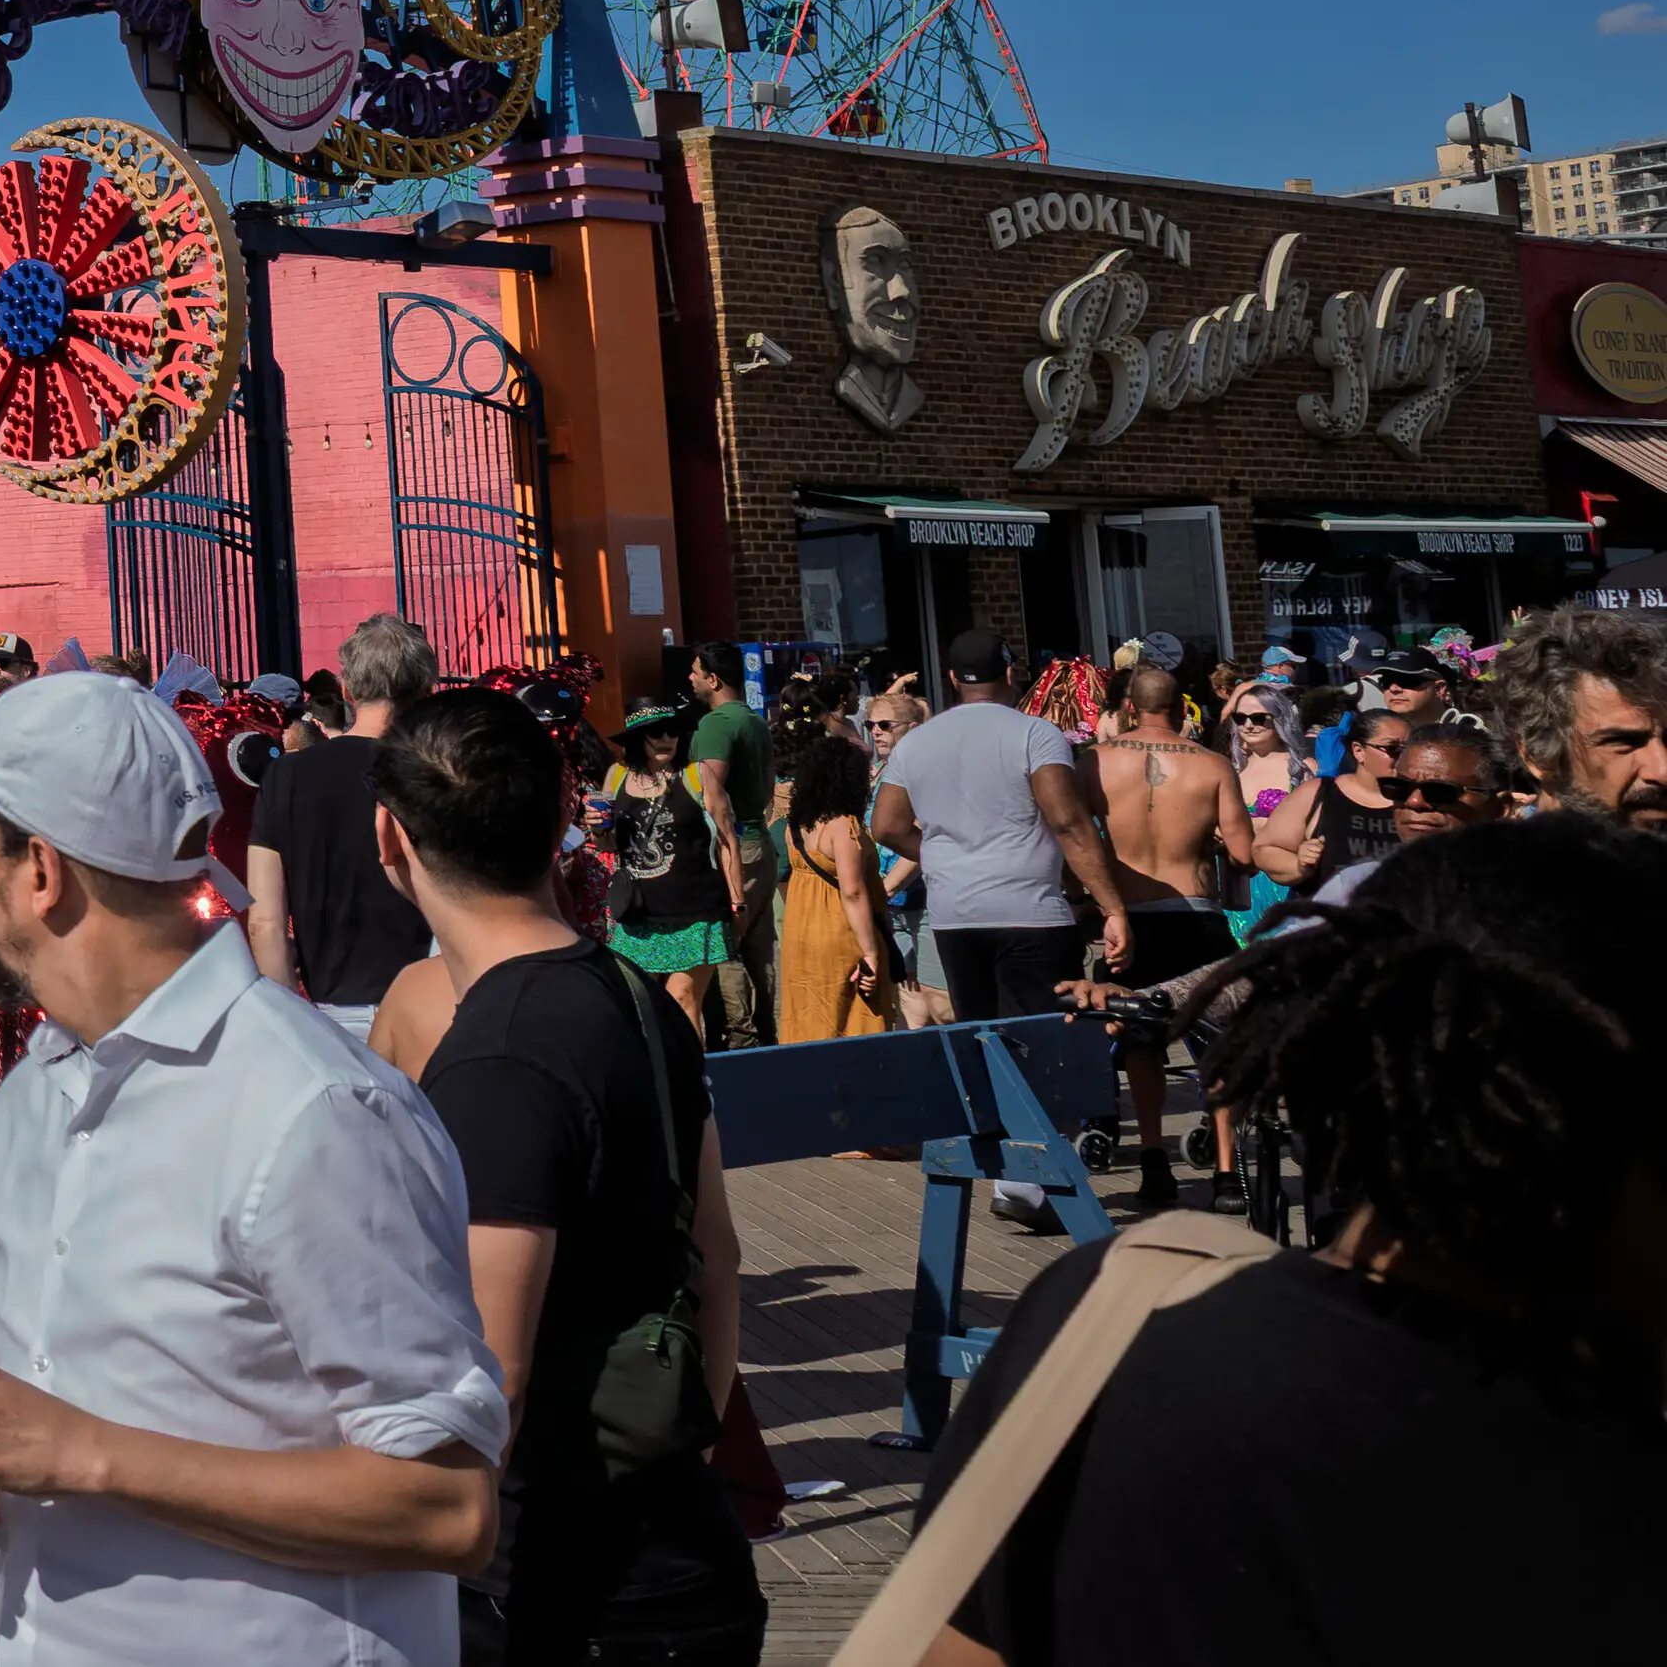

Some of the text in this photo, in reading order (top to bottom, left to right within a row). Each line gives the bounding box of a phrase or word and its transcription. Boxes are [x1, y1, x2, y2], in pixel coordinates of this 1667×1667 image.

[986, 191, 1191, 268] BROOKLYN
[1625, 301, 1634, 324] A
[1593, 330, 1629, 352] CONEY
[1012, 233, 1492, 473] Beach Shop
[1606, 359, 1667, 382] TRADITION
[909, 519, 1036, 547] BROOKLYN BEACH SHOP
[1417, 532, 1515, 554] BROOKLYN BEACH SHOP
[1563, 533, 1585, 553] 1223
